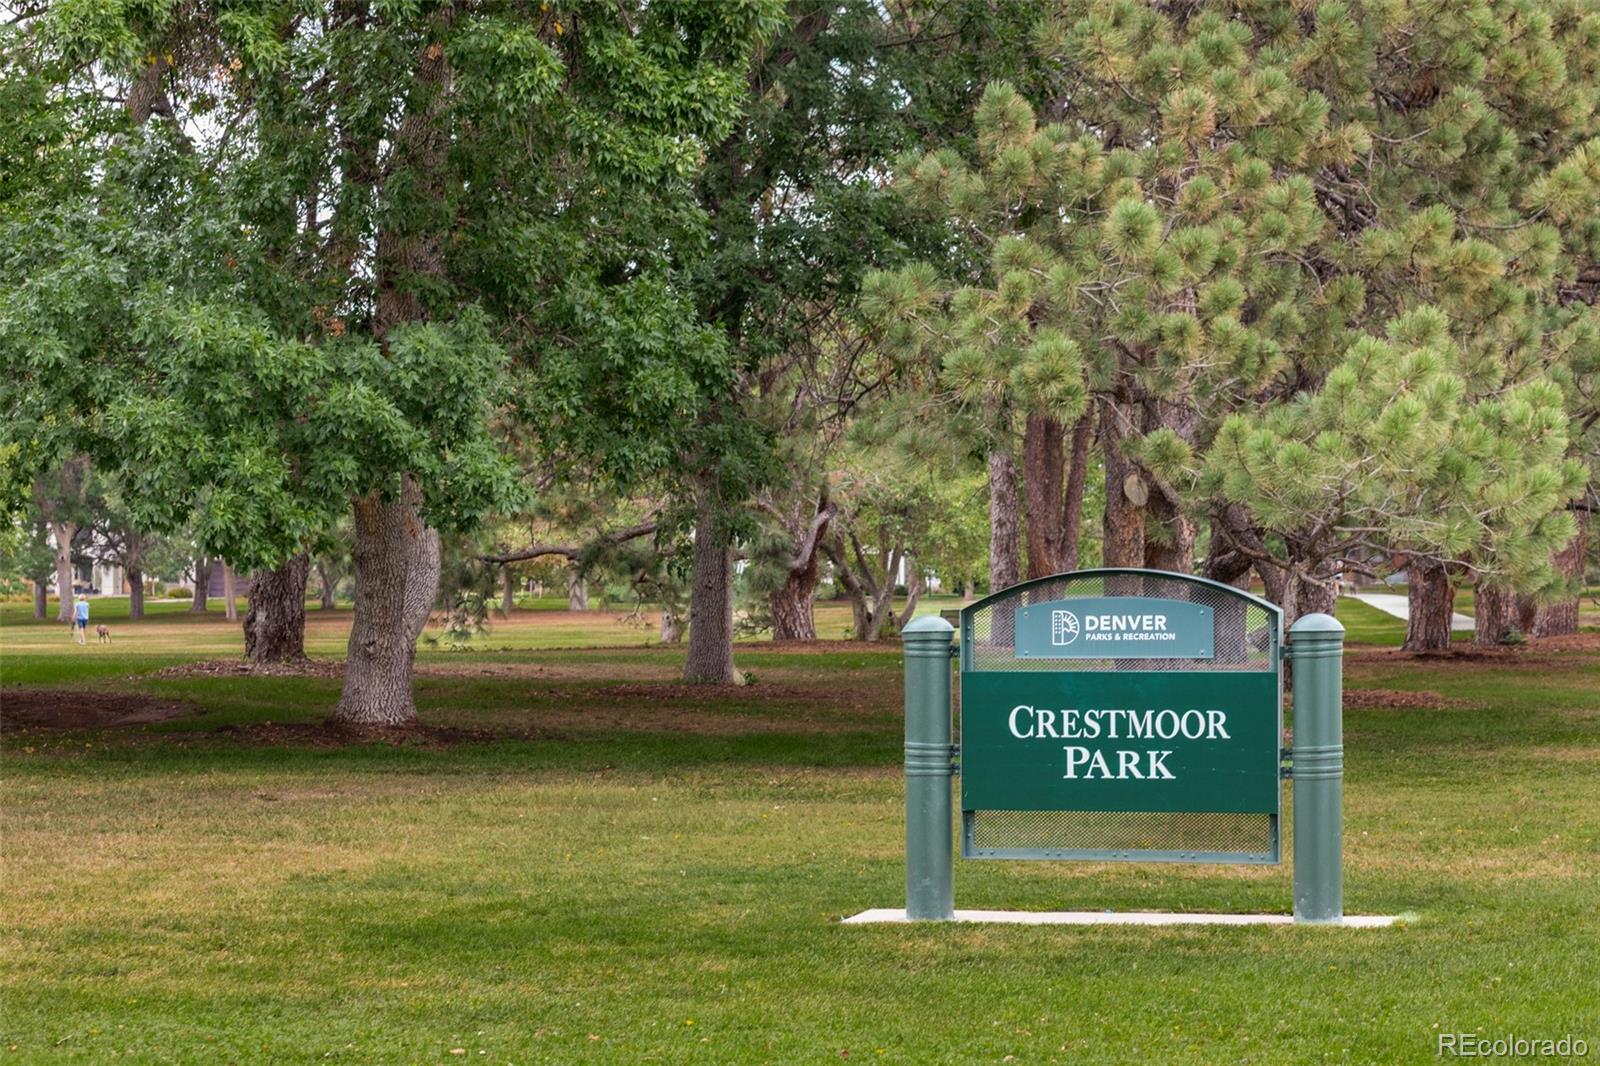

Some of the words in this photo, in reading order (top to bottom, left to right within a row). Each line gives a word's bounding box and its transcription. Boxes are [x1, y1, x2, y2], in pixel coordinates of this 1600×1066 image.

[1085, 615, 1167, 631] DENVER
[1085, 633, 1113, 641] PARKS
[1114, 633, 1122, 641] &
[1123, 633, 1176, 641] RECREATION
[1008, 705, 1231, 740] CRESTMOOR
[1063, 746, 1177, 780] PARK
